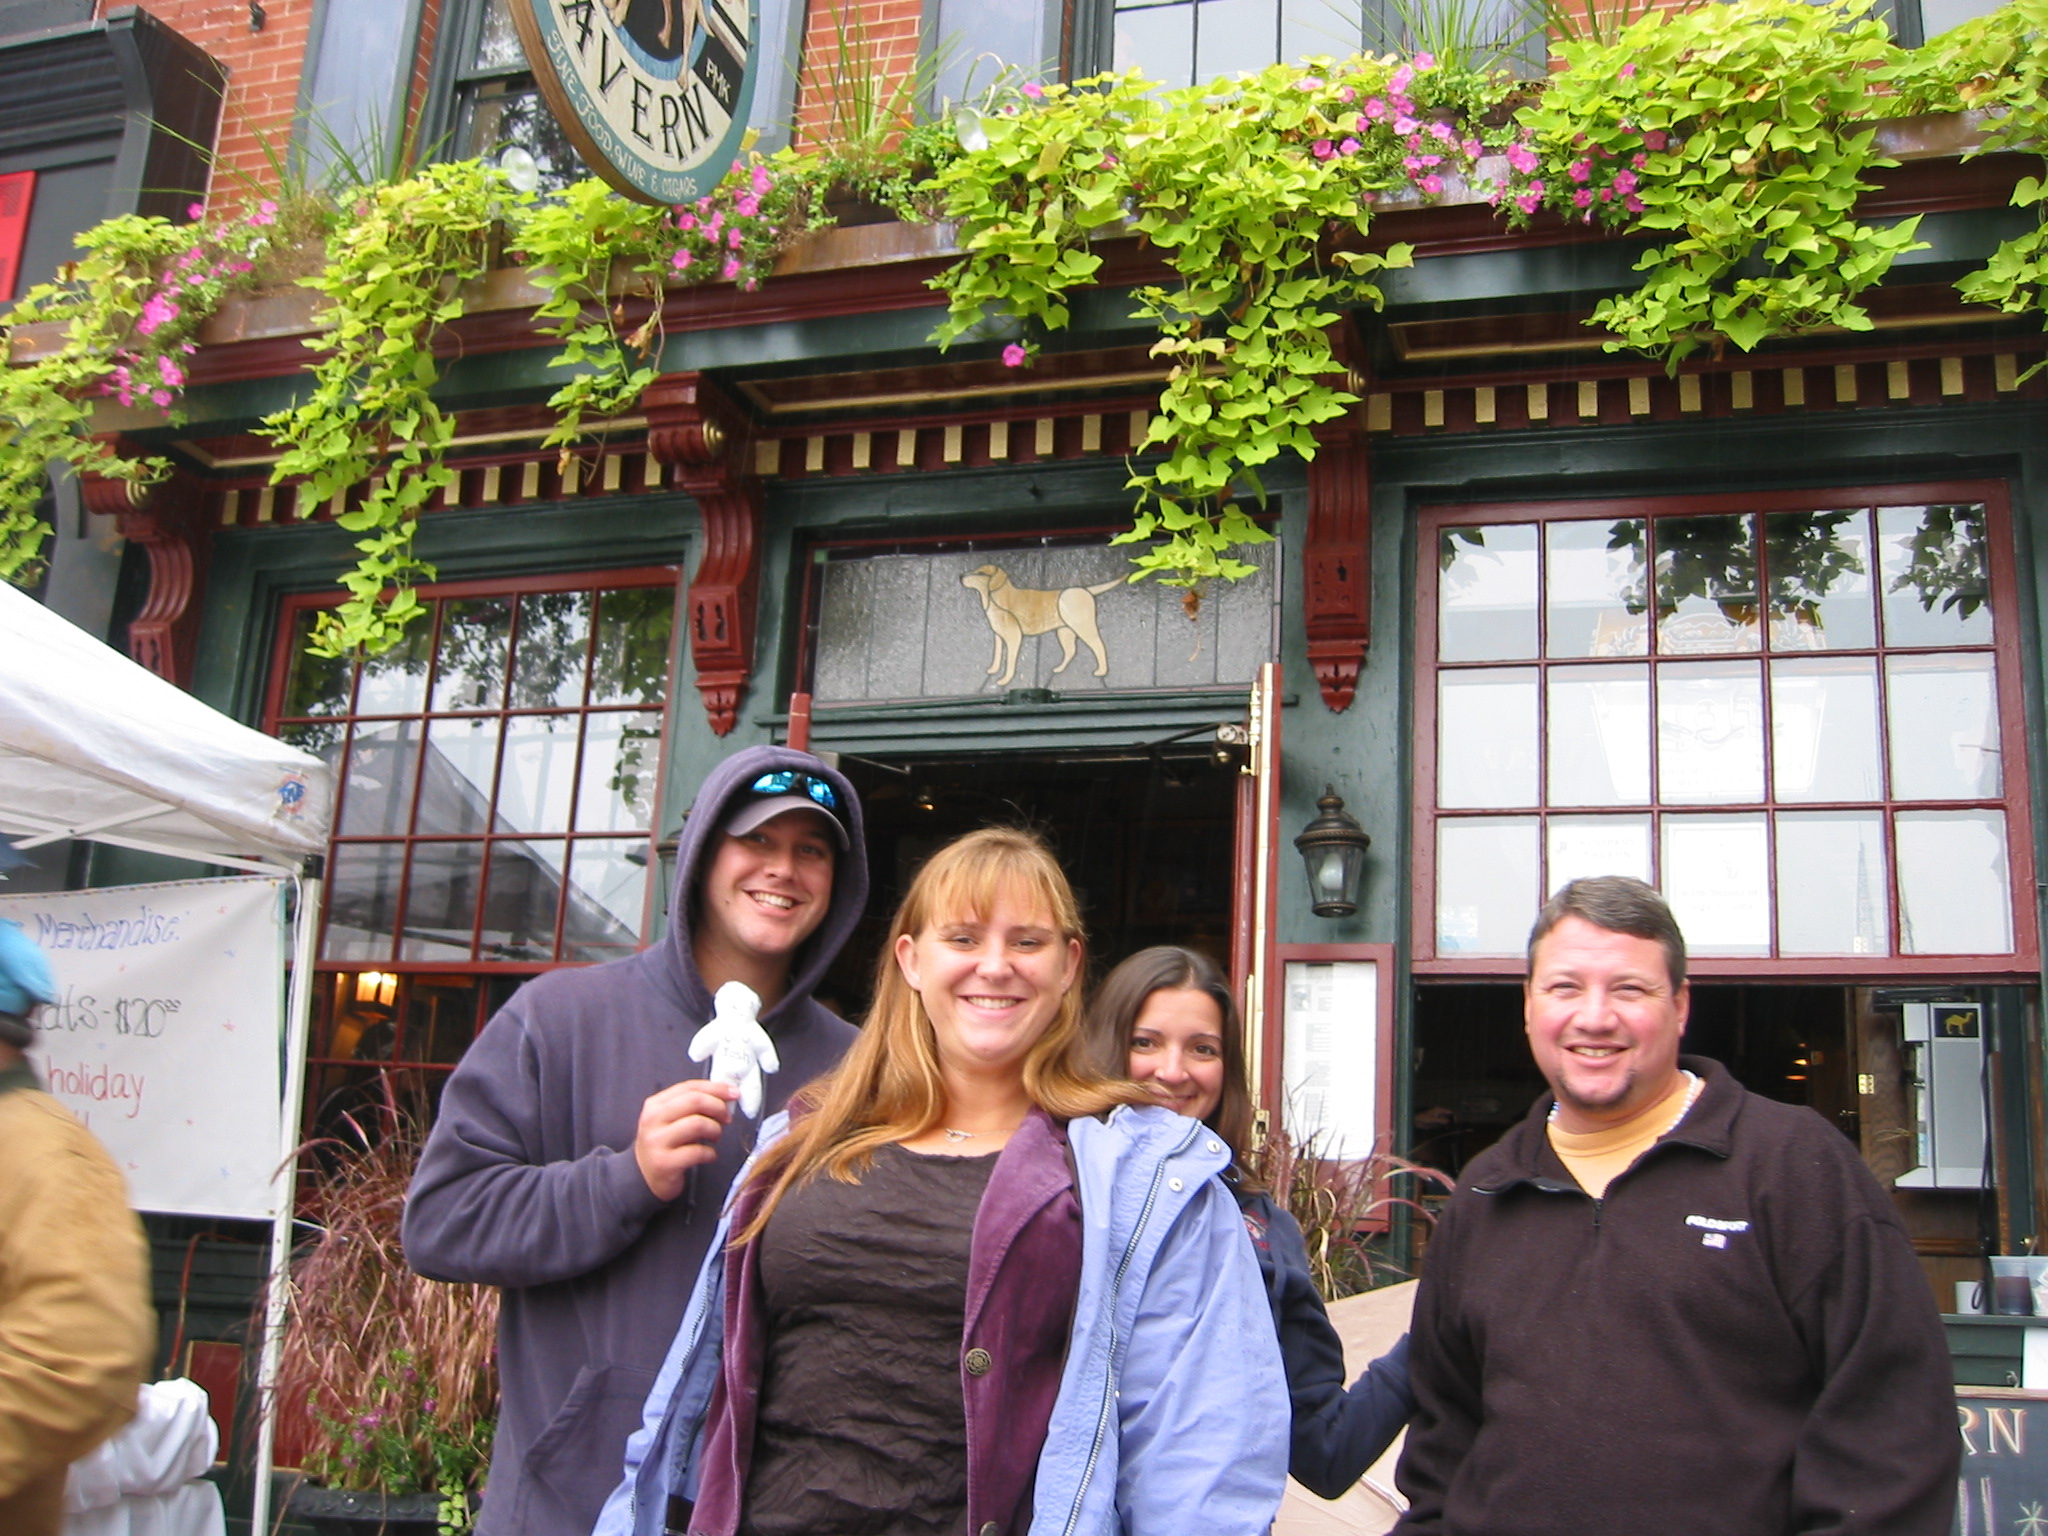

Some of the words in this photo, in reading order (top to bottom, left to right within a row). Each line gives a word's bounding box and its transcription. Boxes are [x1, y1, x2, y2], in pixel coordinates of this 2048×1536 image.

[547, 30, 578, 95] FINE
[614, 146, 647, 187] WINE
[661, 175, 698, 199] CIGARS
[48, 1055, 146, 1119] holiday
